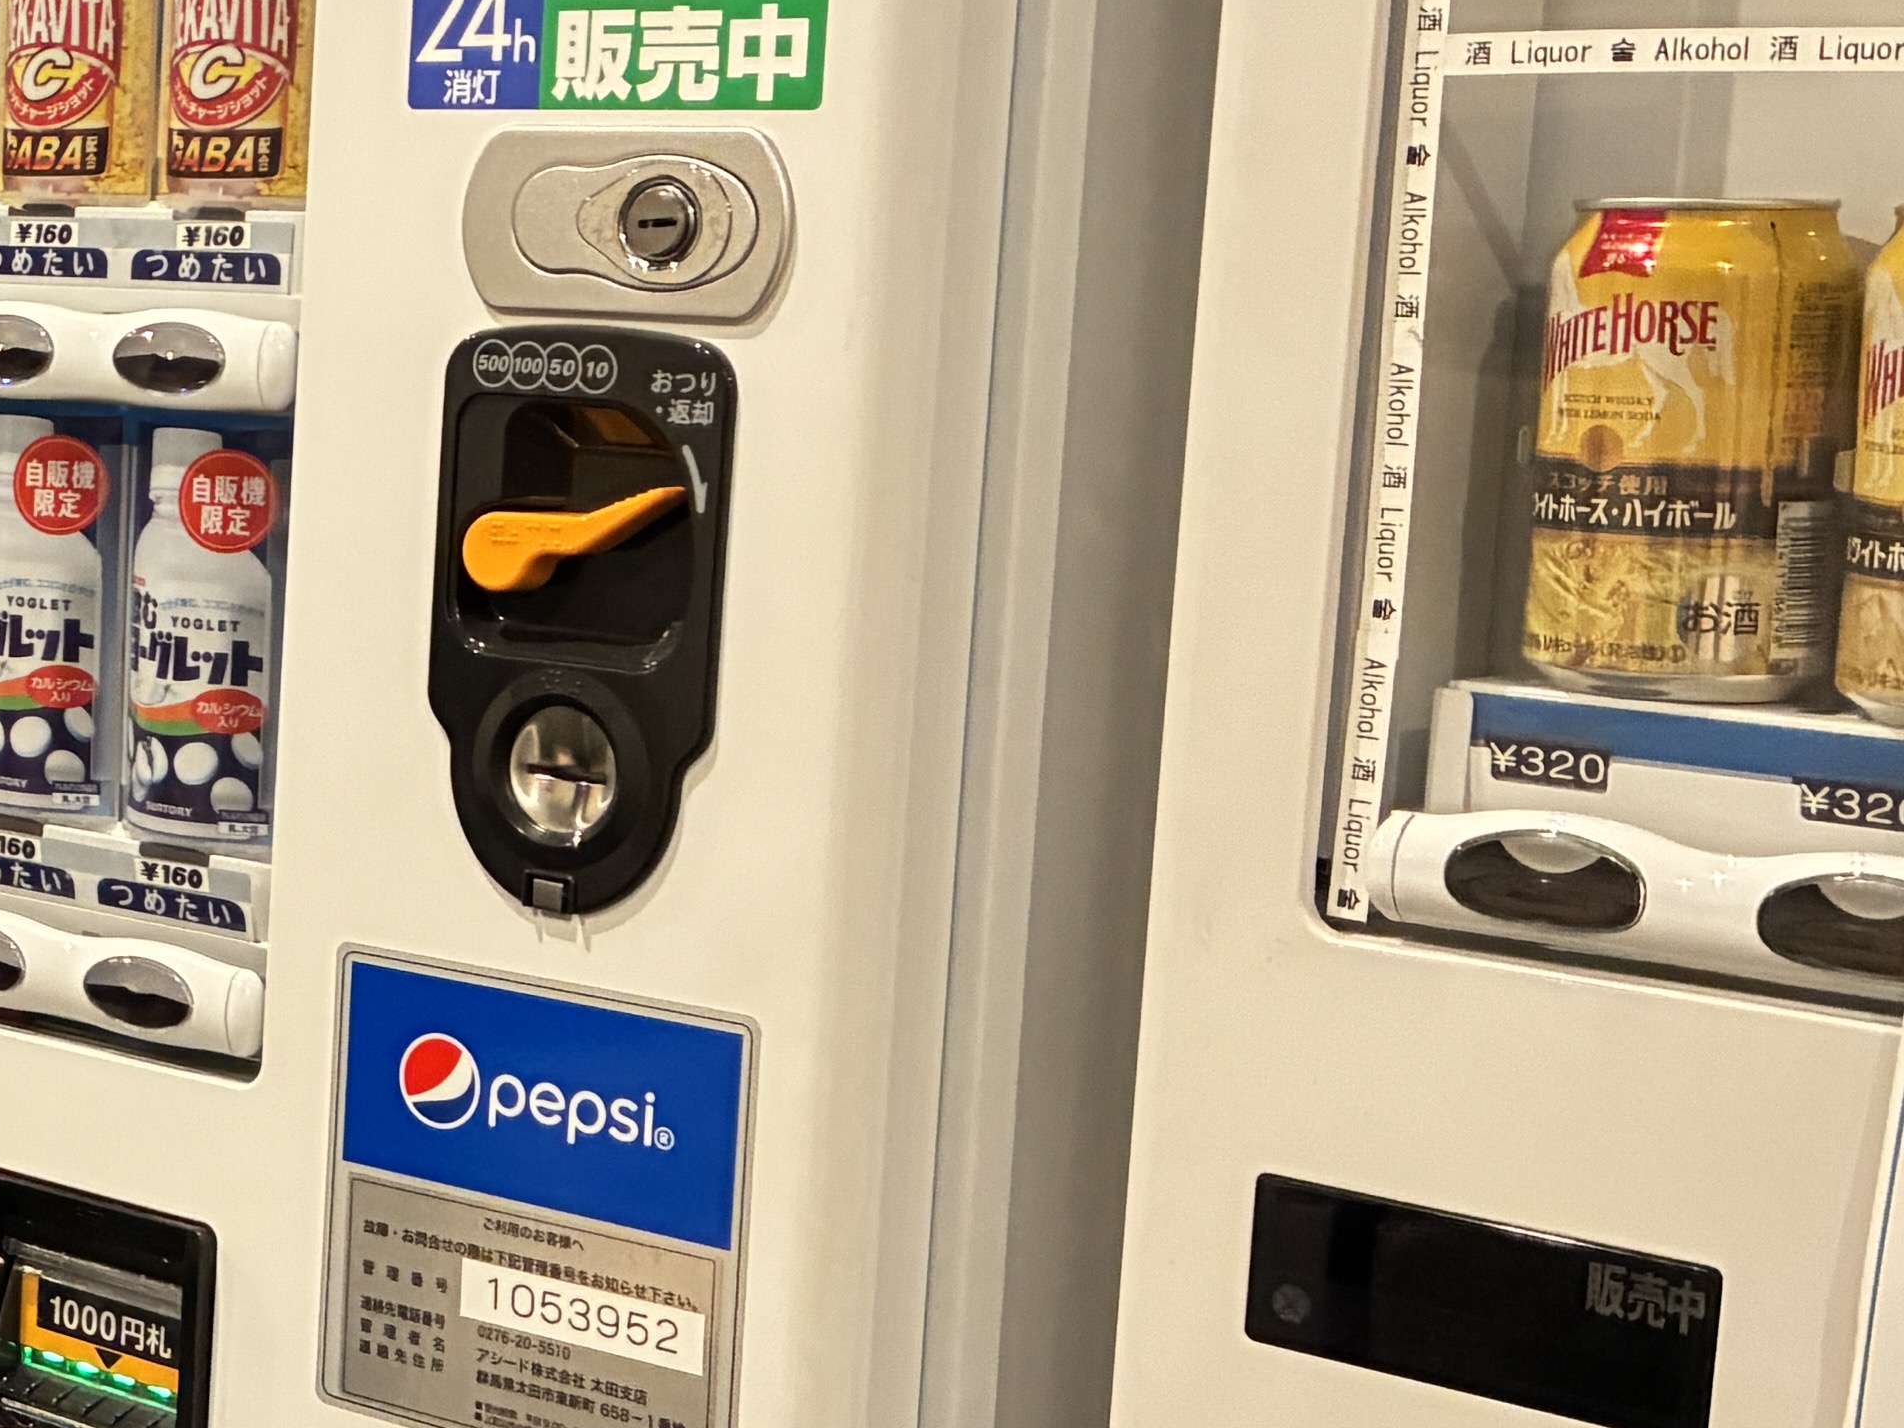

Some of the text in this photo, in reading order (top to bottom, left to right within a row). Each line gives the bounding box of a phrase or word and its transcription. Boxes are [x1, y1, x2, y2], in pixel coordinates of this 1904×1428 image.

[551, 4, 809, 102] 販売中
[1511, 34, 1903, 66] Liquor Alkohol Liquor
[24, 46, 73, 101] C
[443, 70, 501, 104] 消灯
[16, 224, 72, 244] ¥160
[1610, 293, 1719, 356] HORSE
[478, 354, 608, 378] 500 100 50 10
[651, 370, 717, 394] おつり
[25, 460, 94, 491] 自販機
[33, 490, 82, 519] 限定
[201, 506, 250, 536] 限定
[7, 596, 72, 612] YOGLET
[1683, 602, 1760, 636] お酒
[170, 616, 240, 633] YOGLET
[31, 674, 93, 692] カルシウム
[196, 701, 261, 718] カルシウム
[1492, 744, 1605, 784] ¥320
[1585, 1262, 1705, 1336] 販売中
[50, 1295, 172, 1359] 1000円札
[488, 1277, 679, 1354] 1053952
